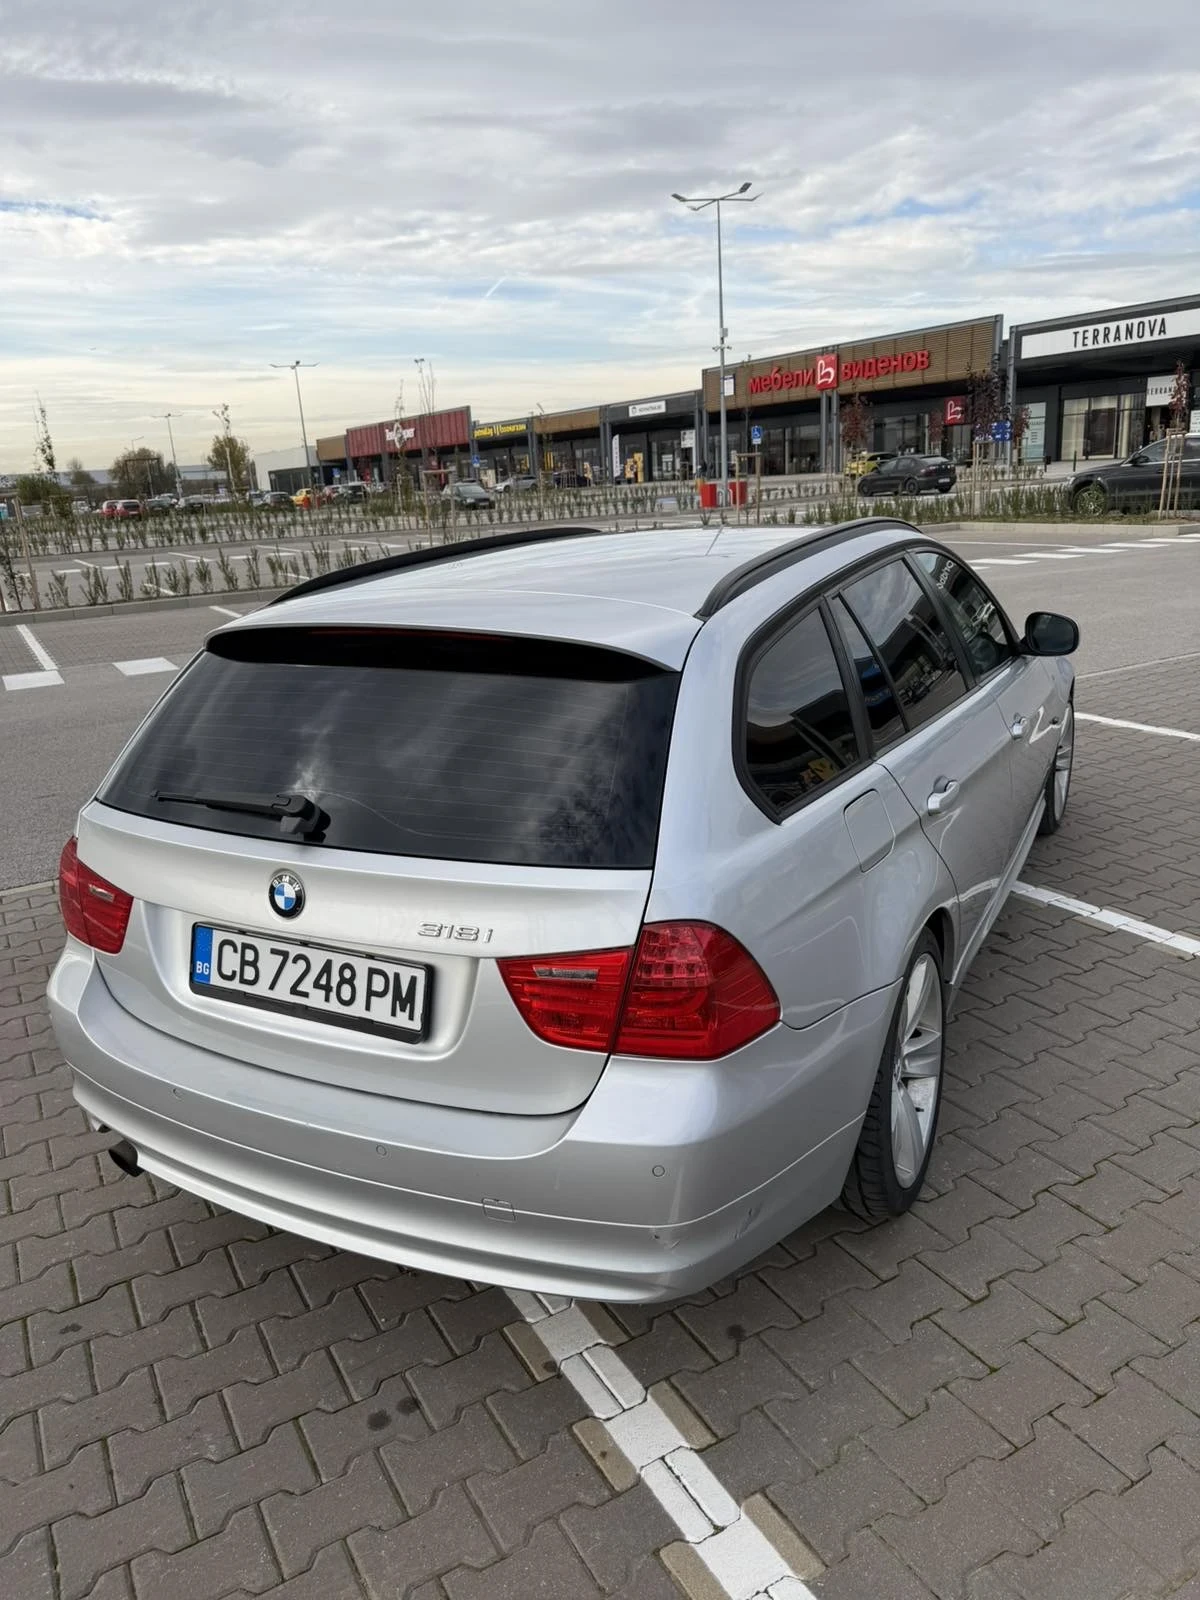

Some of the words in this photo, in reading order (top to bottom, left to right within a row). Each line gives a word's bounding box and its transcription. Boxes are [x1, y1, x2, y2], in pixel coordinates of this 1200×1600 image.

[1073, 317, 1167, 349] TERRANOVA
[748, 365, 815, 394] мебели
[842, 349, 930, 381] виденов
[272, 875, 300, 891] BMW
[196, 961, 210, 976] BG
[217, 939, 260, 987] CB
[267, 948, 357, 1007] 7248
[365, 967, 418, 1021] PM
